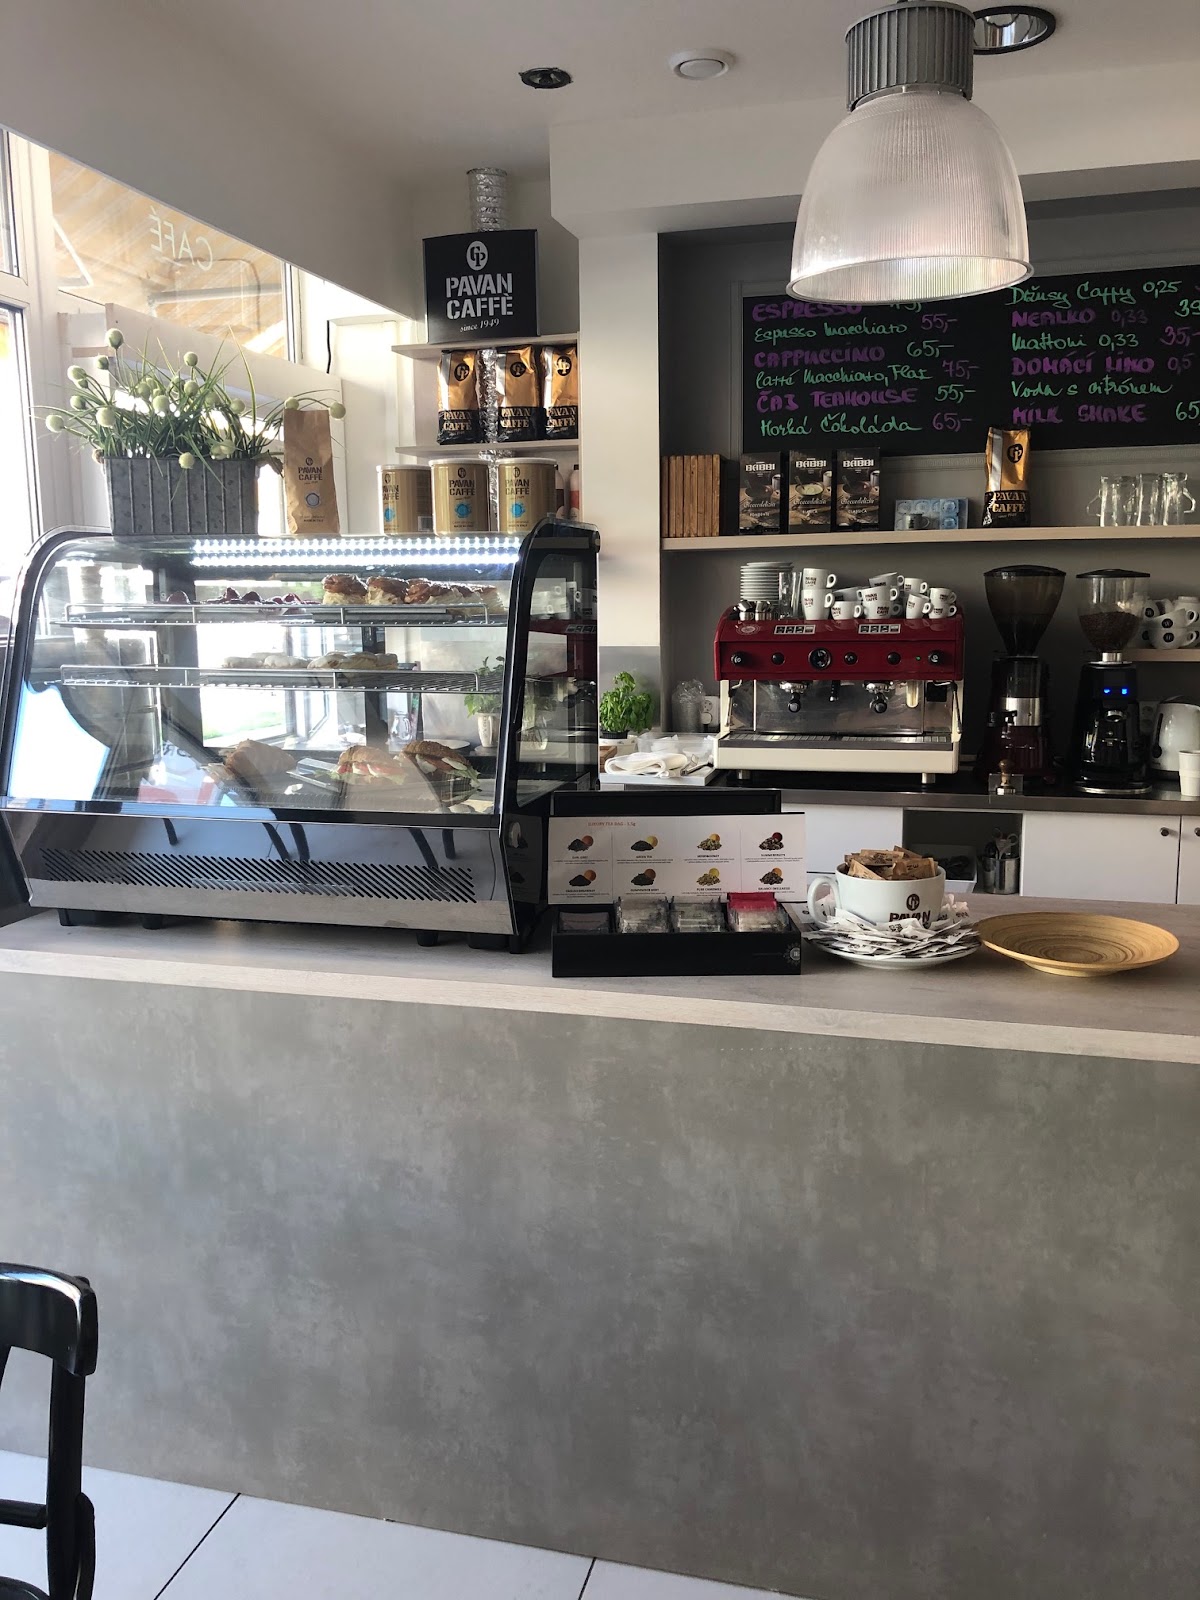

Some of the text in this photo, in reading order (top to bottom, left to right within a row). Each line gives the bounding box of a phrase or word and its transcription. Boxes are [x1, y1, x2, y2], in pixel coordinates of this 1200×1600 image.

[446, 273, 513, 298] PAVAN
[1142, 280, 1183, 299] 0,25
[446, 293, 514, 320] CAFFÈ
[460, 318, 500, 333] since 1949
[1011, 307, 1096, 328] NEALKO
[1111, 308, 1148, 328] 0,33
[1098, 333, 1140, 352] 0,33
[810, 387, 919, 408] TEAHOUSE
[1010, 380, 1064, 398] Voda
[1067, 384, 1079, 396] s
[1077, 403, 1148, 424] SHAKE
[760, 415, 812, 437] Horká
[298, 466, 323, 474] PAVAN
[745, 463, 776, 472] BABBI
[796, 460, 827, 468] BABBI
[842, 459, 875, 468] BABBI
[449, 479, 475, 488] PAVAN
[505, 479, 530, 487] PAVAN
